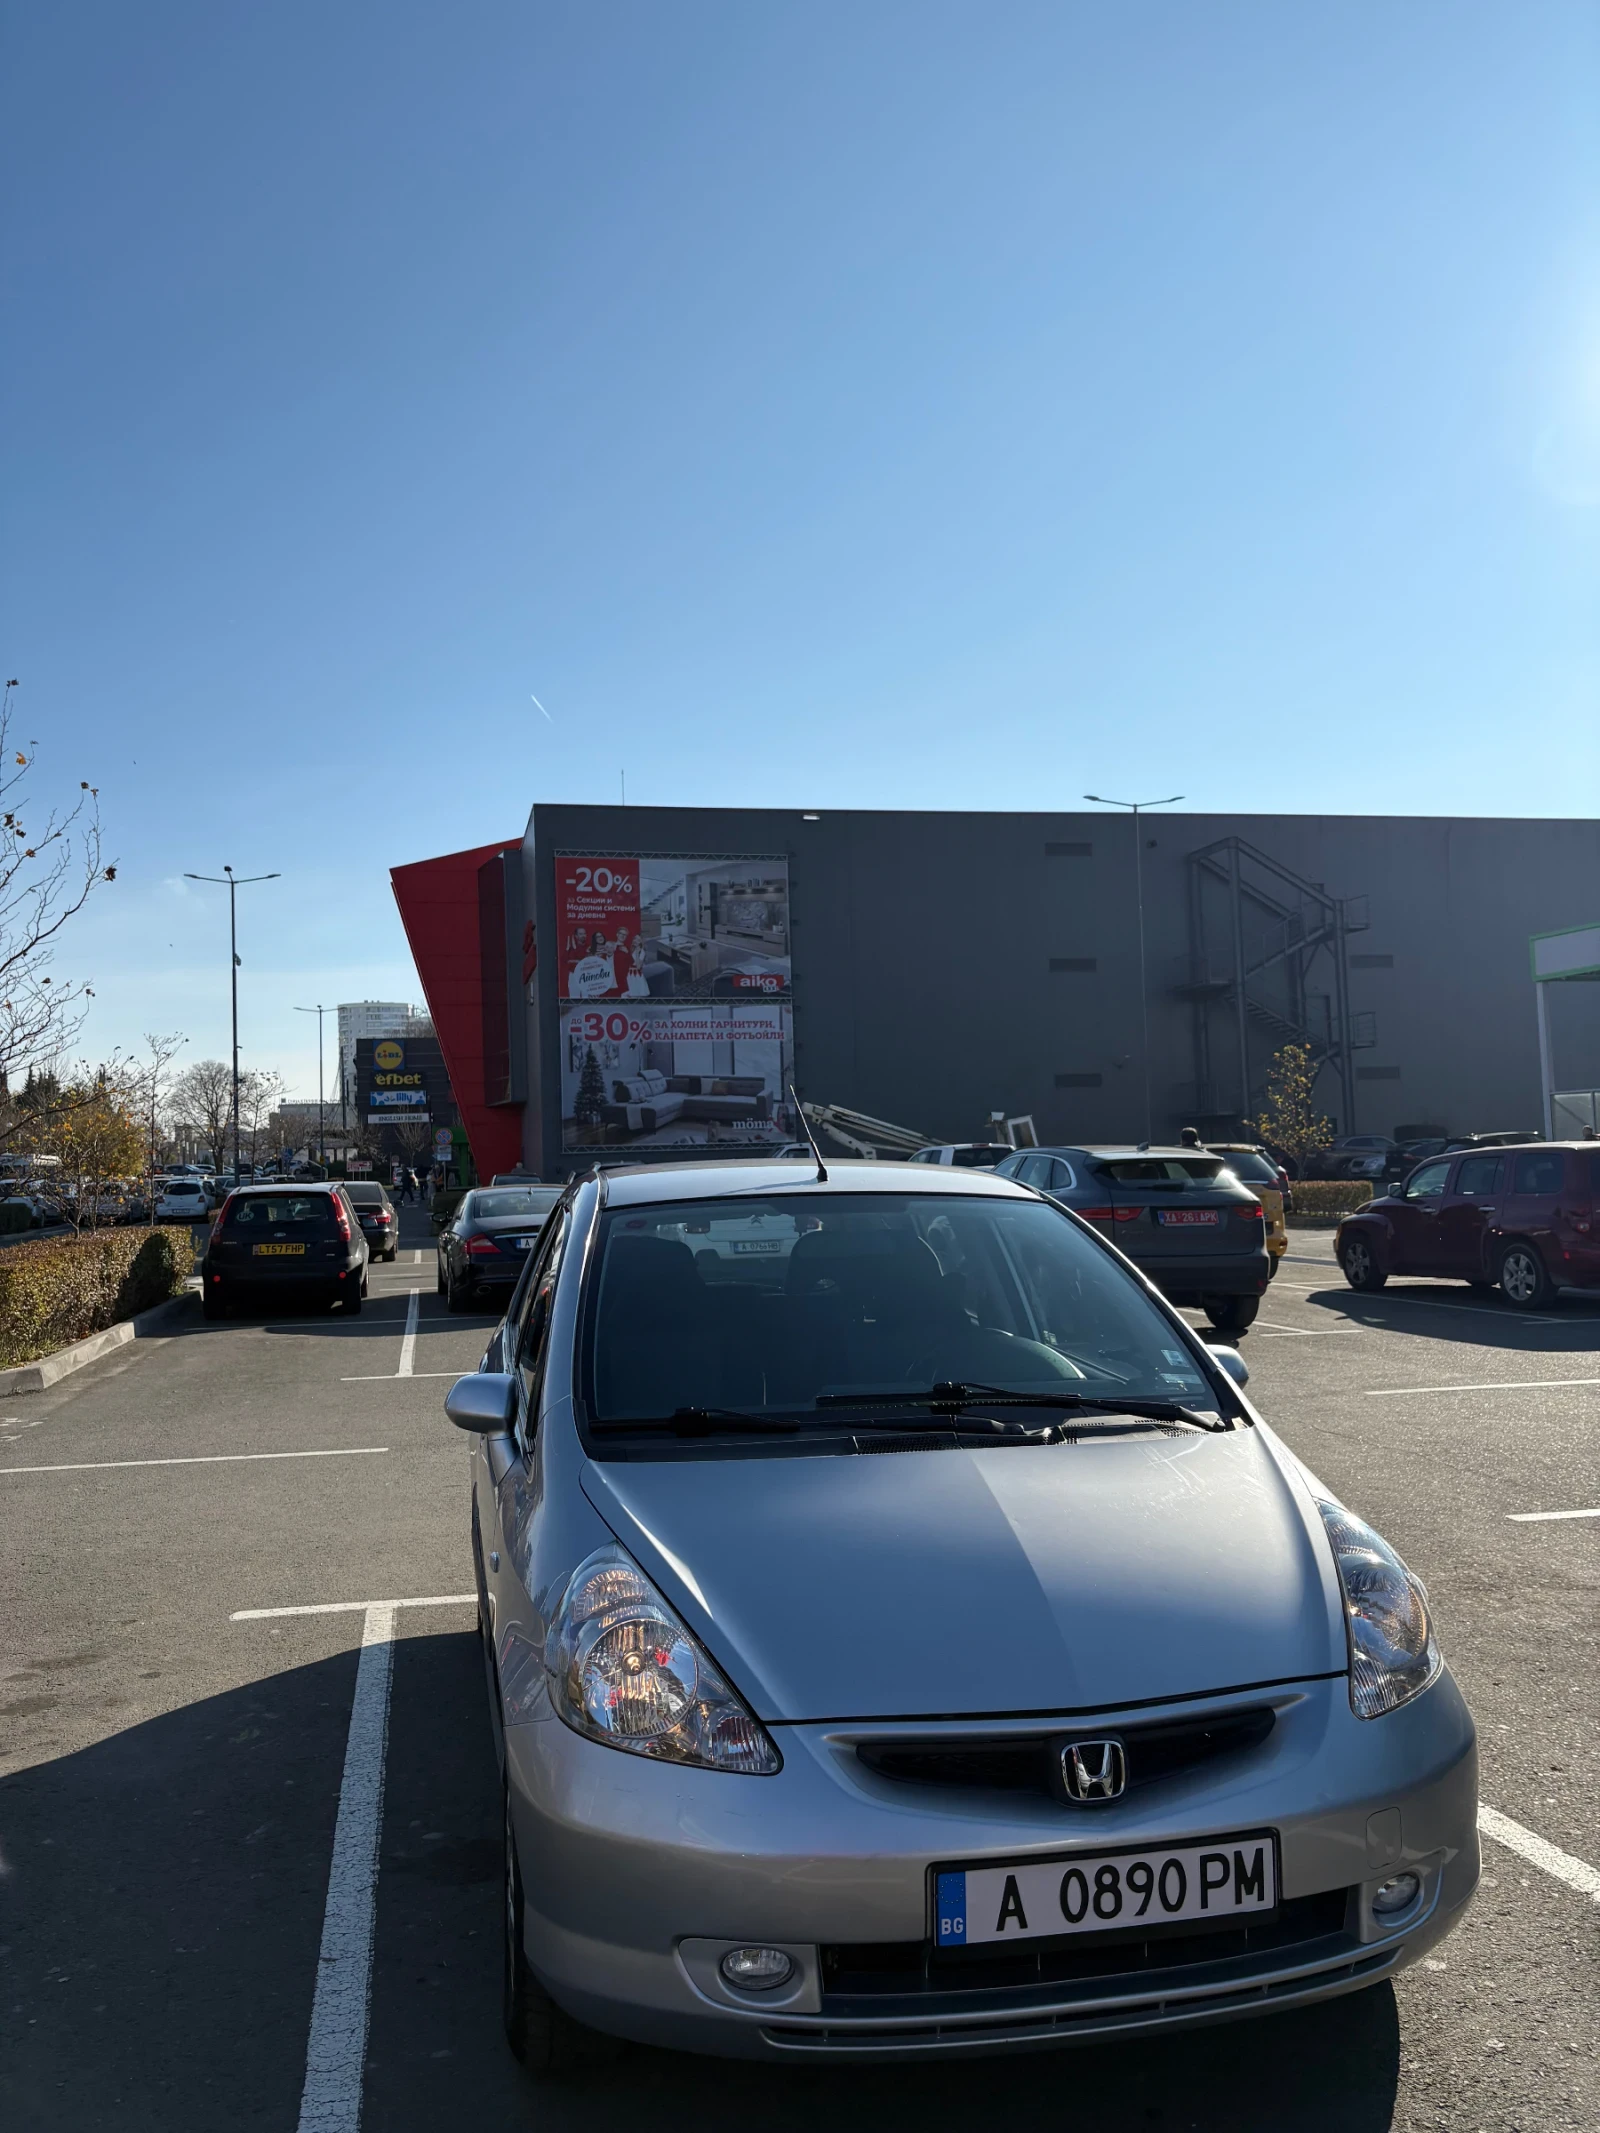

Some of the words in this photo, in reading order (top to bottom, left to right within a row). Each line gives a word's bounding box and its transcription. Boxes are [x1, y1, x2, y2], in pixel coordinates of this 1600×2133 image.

[566, 867, 633, 893] -20%
[576, 896, 606, 904] Секции
[566, 904, 602, 912] Модулни
[739, 975, 777, 987] aiko
[570, 1012, 652, 1041] -30%
[655, 1032, 714, 1040] КАНАПЕТА
[726, 1030, 785, 1039] ФОТЬОЙЛИ
[376, 1073, 422, 1085] efbet
[1182, 1213, 1194, 1222] 26
[259, 1244, 283, 1254] LT57
[285, 1244, 304, 1253] FHP
[941, 1918, 964, 1936] BG
[995, 1874, 1028, 1932] A
[1060, 1857, 1187, 1924] 0890
[1199, 1847, 1265, 1910] PM
